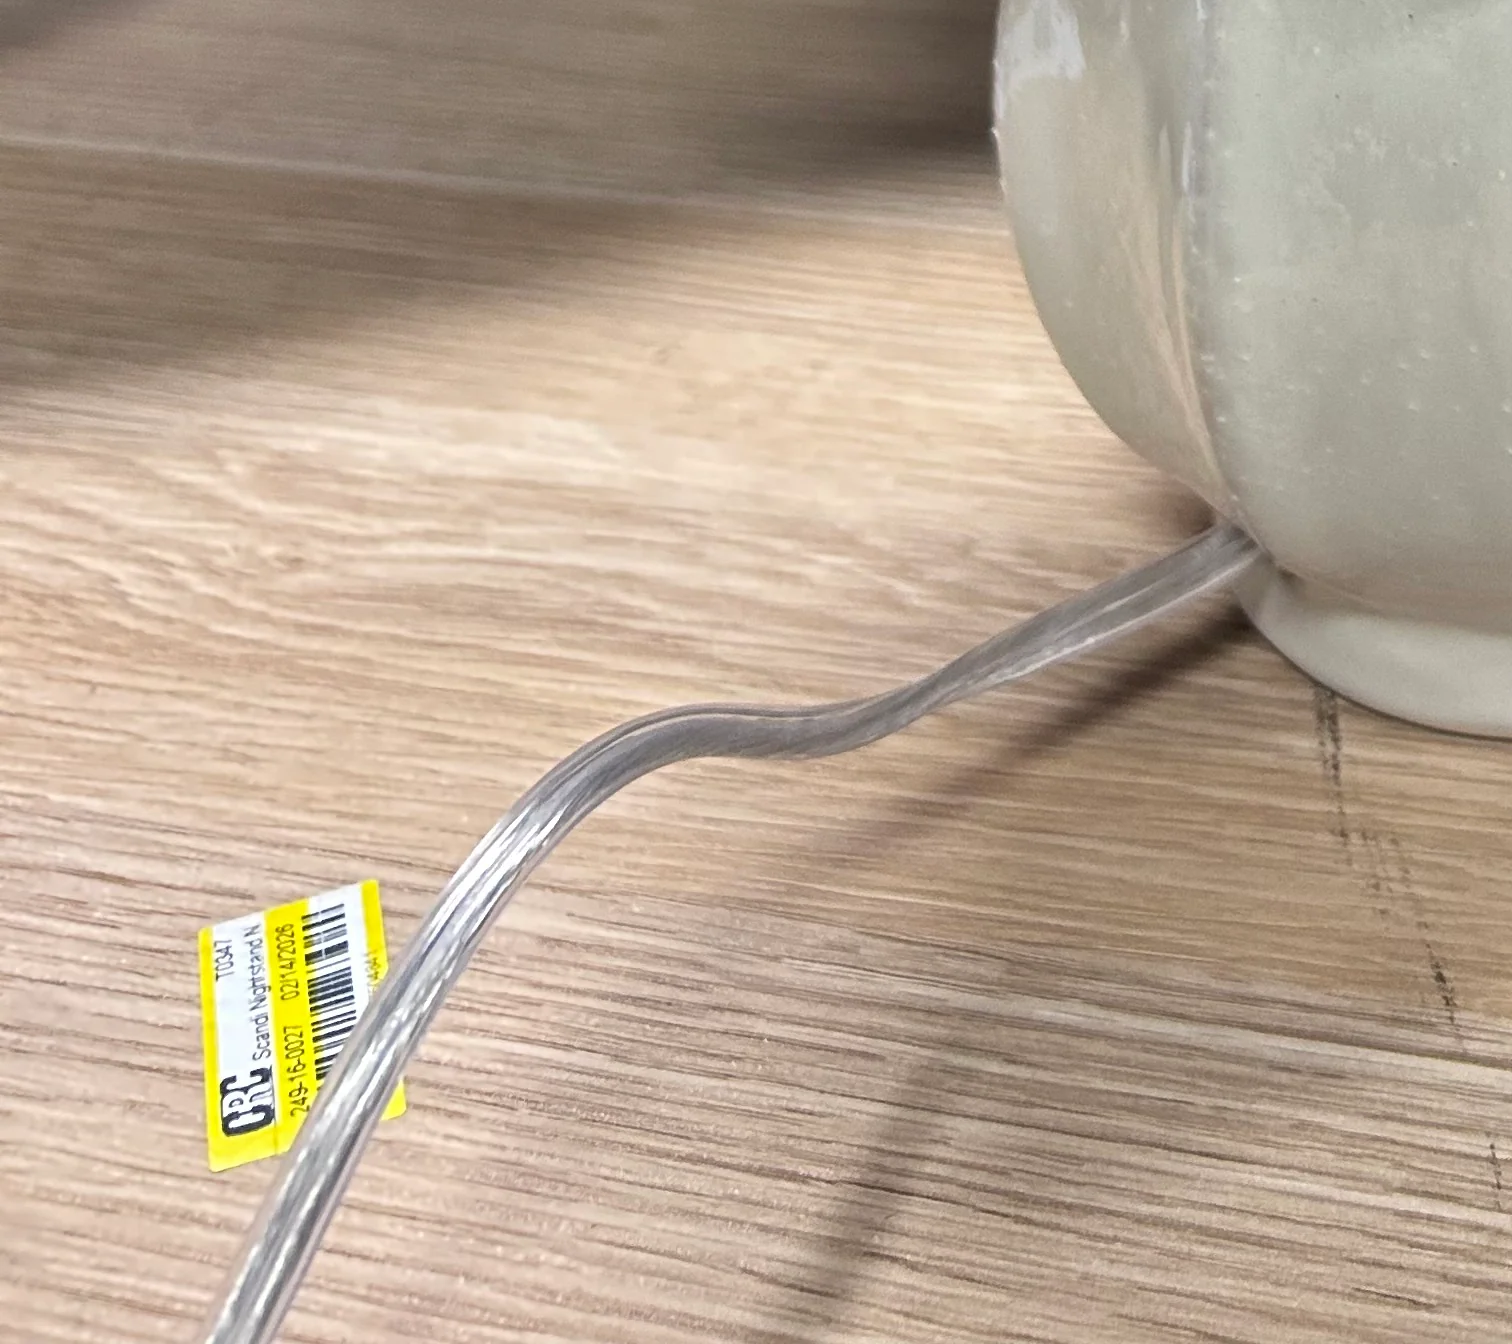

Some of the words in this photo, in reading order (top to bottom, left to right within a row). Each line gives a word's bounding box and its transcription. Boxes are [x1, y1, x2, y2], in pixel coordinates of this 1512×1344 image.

[215, 939, 236, 982] T0347
[246, 936, 272, 1011] Nightstand
[275, 923, 301, 1002] 02/14/2026
[251, 1011, 271, 1061] Scandi
[283, 1024, 311, 1118] 249-16-0027
